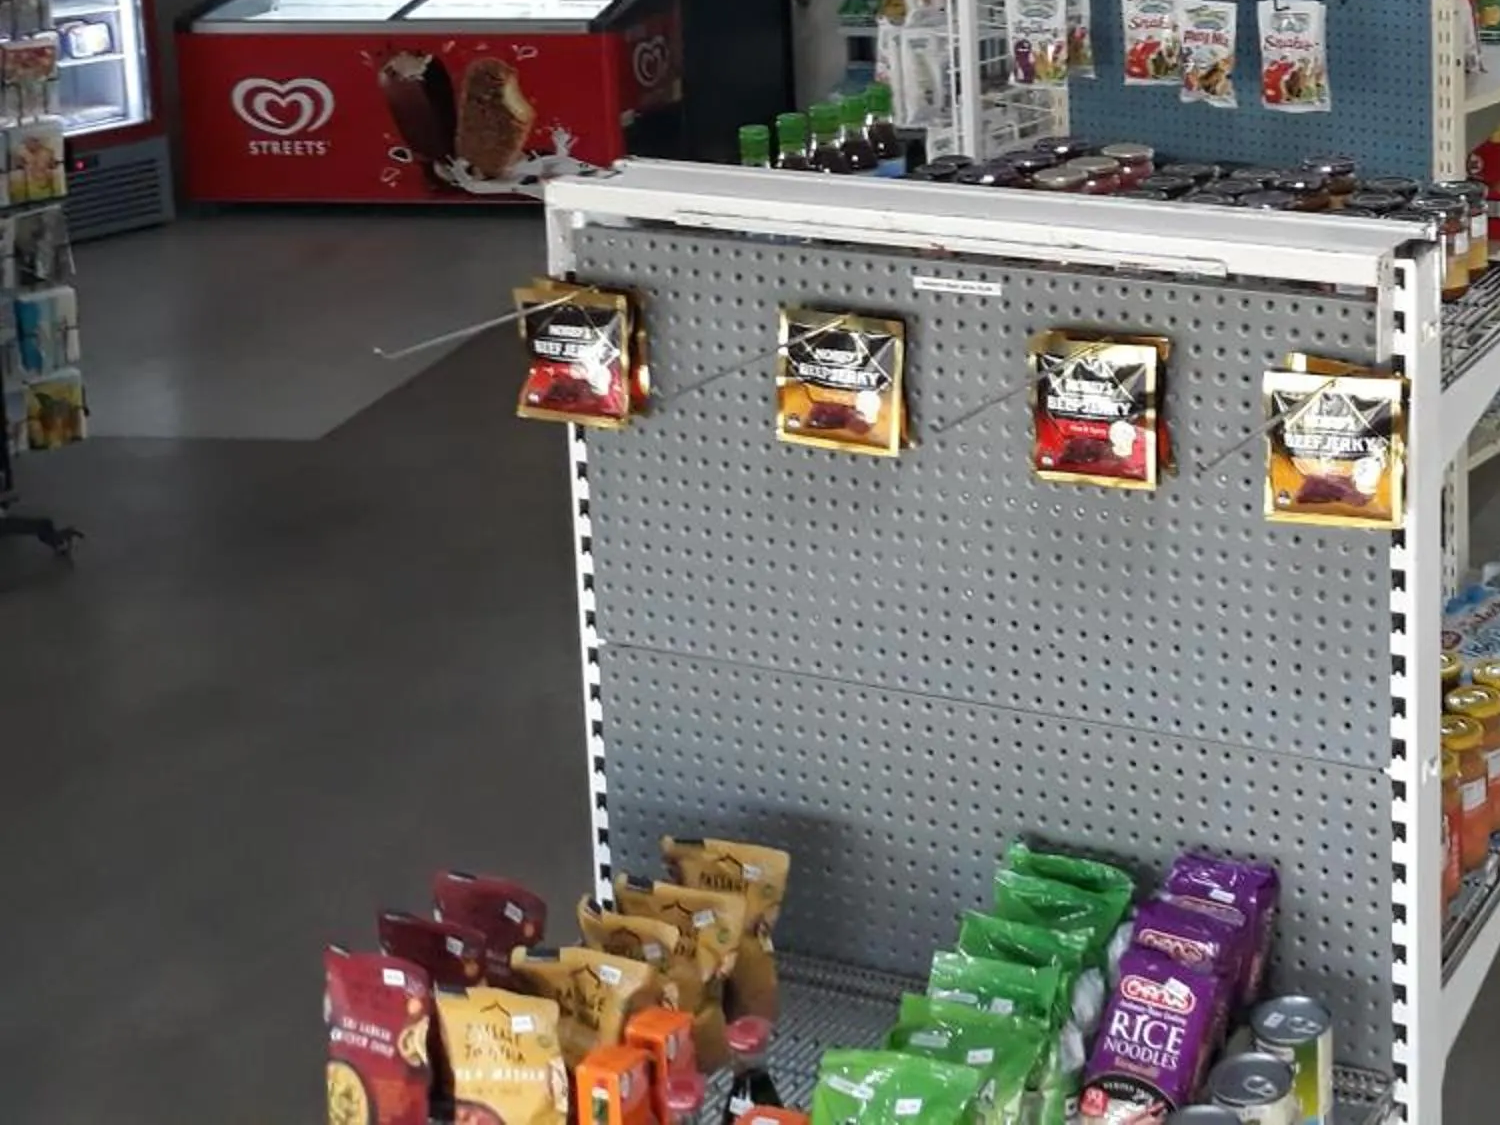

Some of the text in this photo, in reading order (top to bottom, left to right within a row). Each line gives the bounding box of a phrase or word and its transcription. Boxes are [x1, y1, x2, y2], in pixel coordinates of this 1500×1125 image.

[248, 139, 327, 156] STREETS
[799, 362, 881, 389] BEEF JERKY
[1046, 394, 1133, 417] BEEF JERKY
[1325, 436, 1376, 454] JERKY
[1109, 1009, 1187, 1056] RICE
[1103, 1035, 1180, 1071] NOODLES
